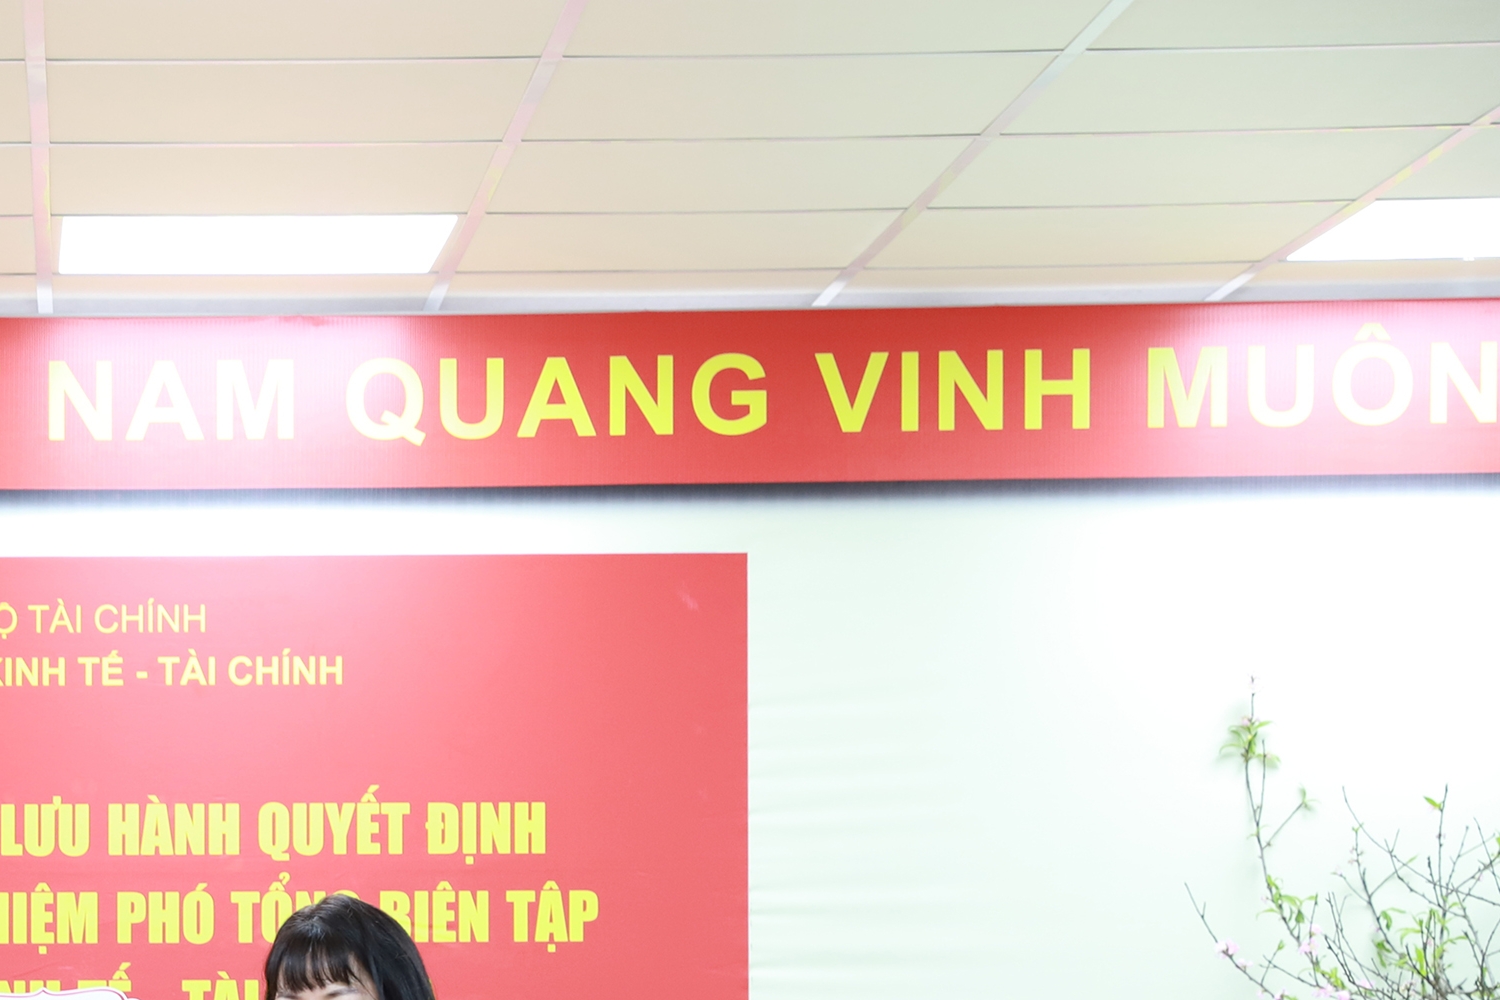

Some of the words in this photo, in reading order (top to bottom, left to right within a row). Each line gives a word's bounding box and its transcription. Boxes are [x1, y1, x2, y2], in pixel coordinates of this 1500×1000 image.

[47, 358, 295, 442] NAM
[345, 352, 767, 447] QUANG
[815, 348, 1091, 433] VINH
[1146, 322, 1498, 429] MUÔN
[27, 598, 82, 634] TÀI
[94, 597, 206, 634] CHÍNH
[77, 649, 125, 687] TẾ
[136, 671, 148, 679] -
[157, 648, 217, 687] TÀI
[227, 648, 344, 687] CHÍNH
[1, 795, 90, 857] LƯU
[107, 794, 241, 856] HÀNH
[257, 784, 411, 862] QUYẾT
[424, 801, 546, 865] ĐỊNH
[116, 883, 215, 944] PHÓ
[379, 881, 490, 943] BIÊN
[505, 880, 599, 953] TẬP
